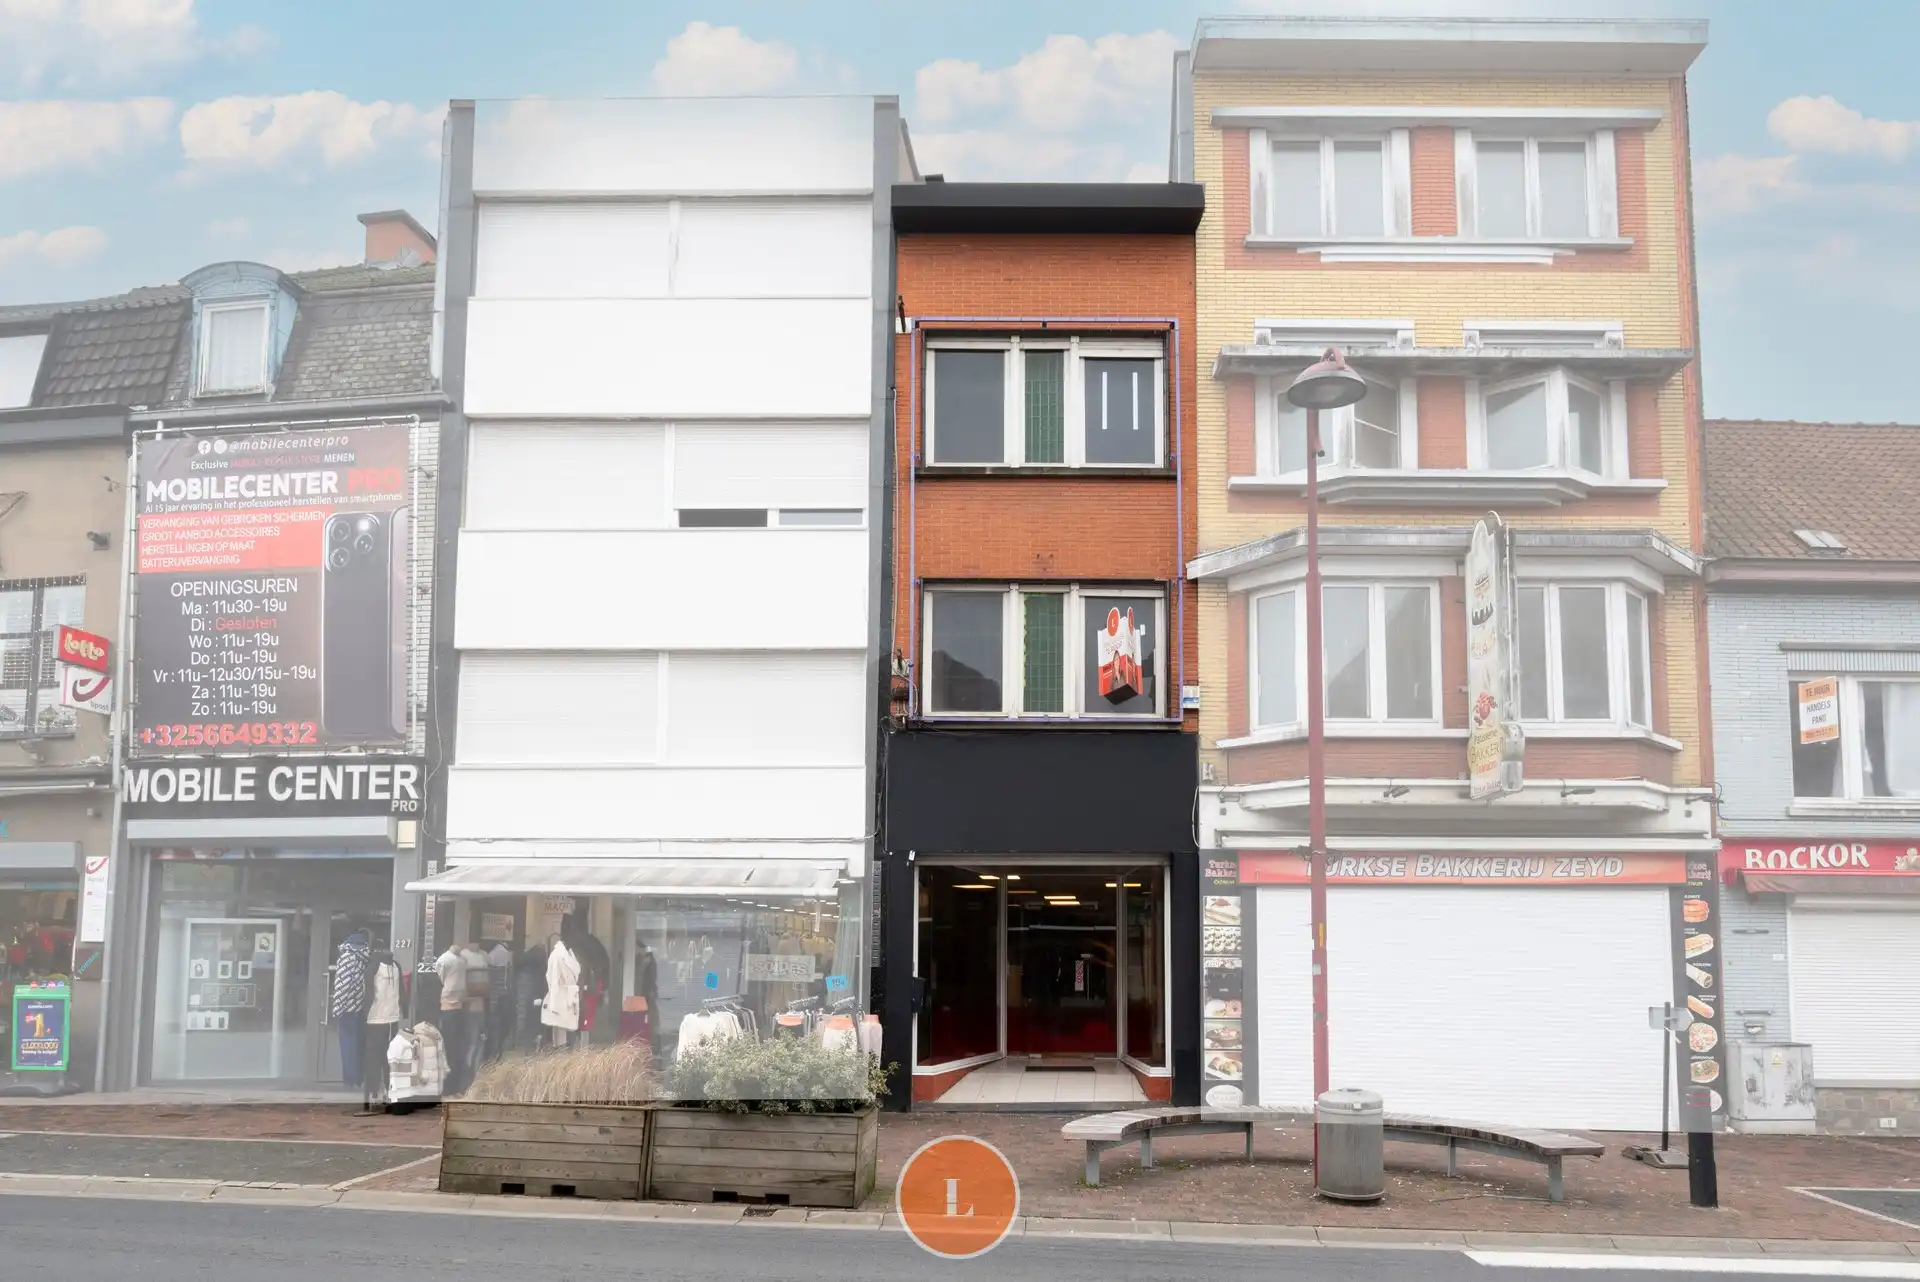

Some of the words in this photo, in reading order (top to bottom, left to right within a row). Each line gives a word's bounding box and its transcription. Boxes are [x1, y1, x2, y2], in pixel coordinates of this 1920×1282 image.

[229, 435, 350, 453] @mobilecenterpro
[190, 459, 229, 471] Exclusive
[324, 453, 355, 463] MENEN
[145, 471, 339, 503] MOBILECENTER
[349, 468, 402, 491] PRO
[154, 504, 164, 513] 15
[164, 503, 180, 513] jaar
[180, 501, 213, 512] ervaring
[214, 499, 222, 509] in
[223, 498, 237, 509] het
[238, 497, 291, 510] professioneel
[292, 496, 332, 506] herstellen
[333, 496, 348, 504] van
[349, 493, 403, 505] smartphones
[142, 516, 200, 529] VERVANGING
[201, 515, 220, 527] VAN
[221, 513, 272, 526] GEBROKEN
[273, 511, 326, 523] SCHERMEN
[142, 530, 173, 542] GROOT
[175, 529, 214, 540] AANBOD
[214, 526, 281, 539] ACCESSOIRES
[141, 542, 215, 555] HERSTELLINGEN
[215, 541, 229, 552] OP
[230, 540, 256, 551] MAAT
[170, 577, 299, 598] OPENINGSUREN
[181, 601, 202, 615] Ma
[190, 618, 206, 631] Di
[215, 616, 278, 631] Gesloten
[188, 634, 212, 648] Wo
[190, 651, 210, 665] Do
[153, 669, 169, 682] Vr
[191, 685, 210, 699] Za
[89, 699, 109, 711] bpost
[191, 702, 210, 716] Zo
[139, 721, 318, 746] +3256649332
[122, 766, 257, 803] MOBILE
[267, 764, 420, 801] CENTER
[390, 799, 418, 813] PRO
[1744, 842, 1870, 870] BOCKOR
[1415, 854, 1547, 878] BAKKERIJ
[1552, 856, 1624, 878] ZEYD
[395, 939, 411, 948] 227
